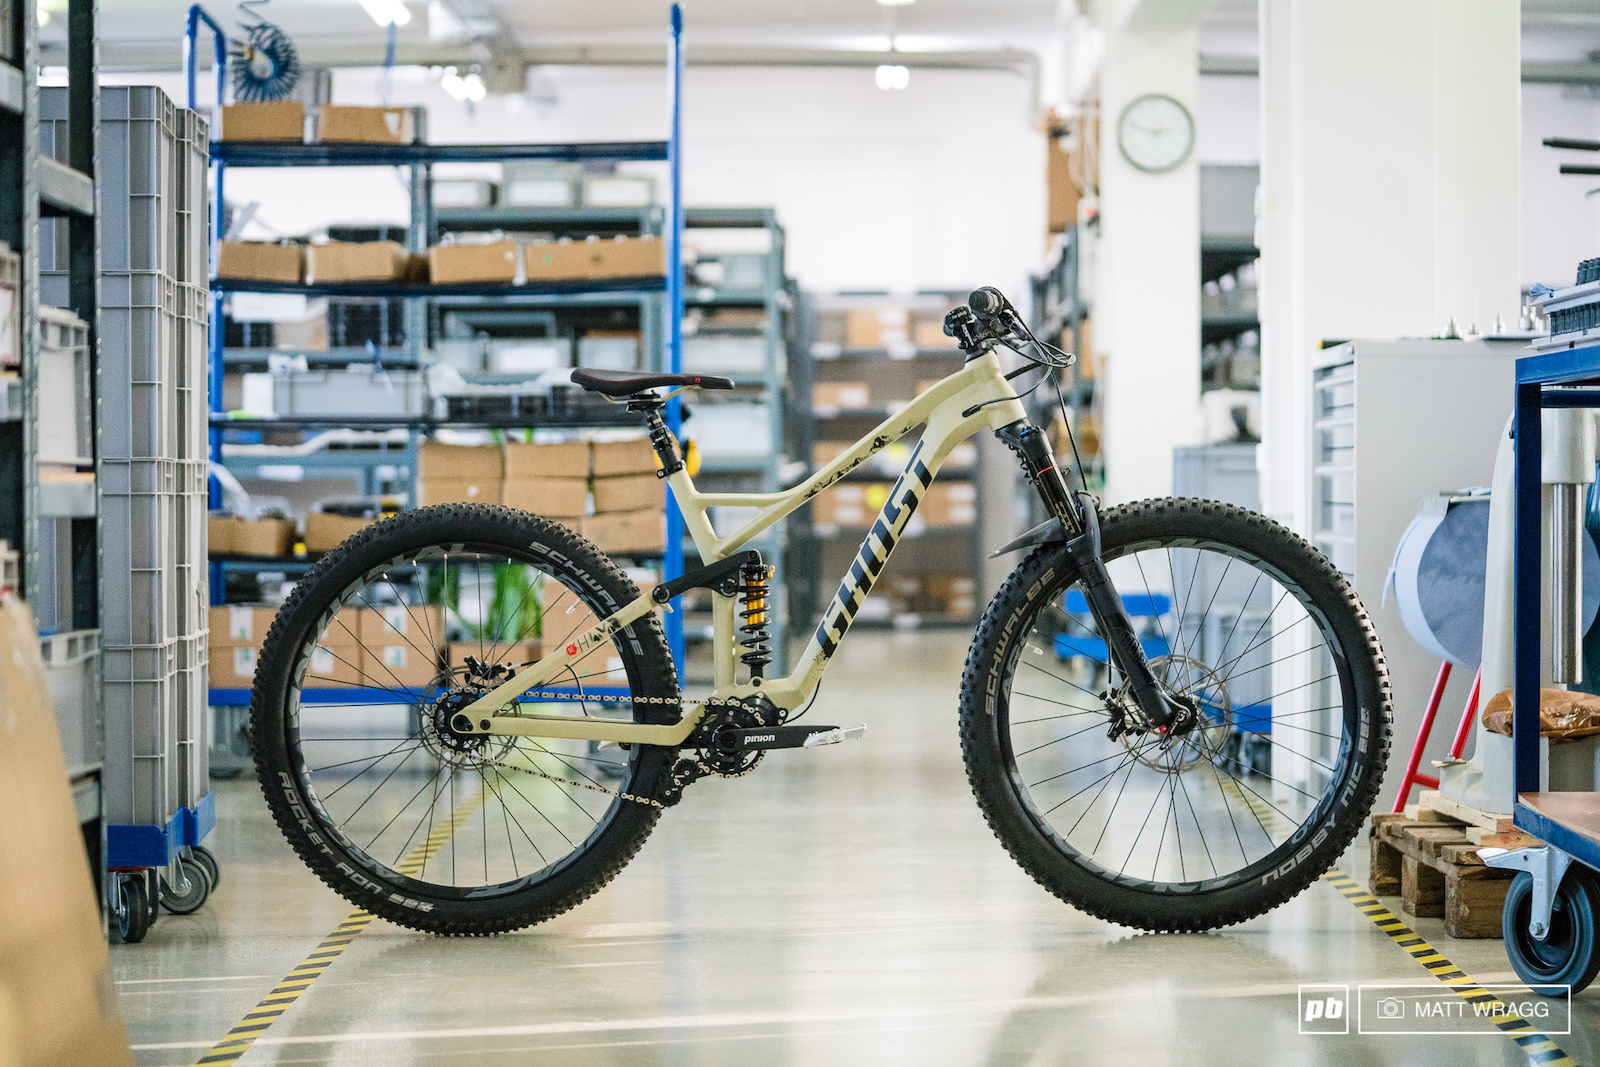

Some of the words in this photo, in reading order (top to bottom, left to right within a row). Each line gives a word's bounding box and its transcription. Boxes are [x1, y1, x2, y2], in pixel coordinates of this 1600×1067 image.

[529, 541, 645, 655] SCHWABE
[816, 439, 933, 658] GHOST
[985, 567, 1055, 716] SCHWALBE
[744, 734, 775, 745] pinion
[278, 771, 334, 855] ROCKET
[335, 861, 383, 895] RON
[1262, 812, 1336, 886] NOBBY
[1340, 761, 1363, 807] NIC
